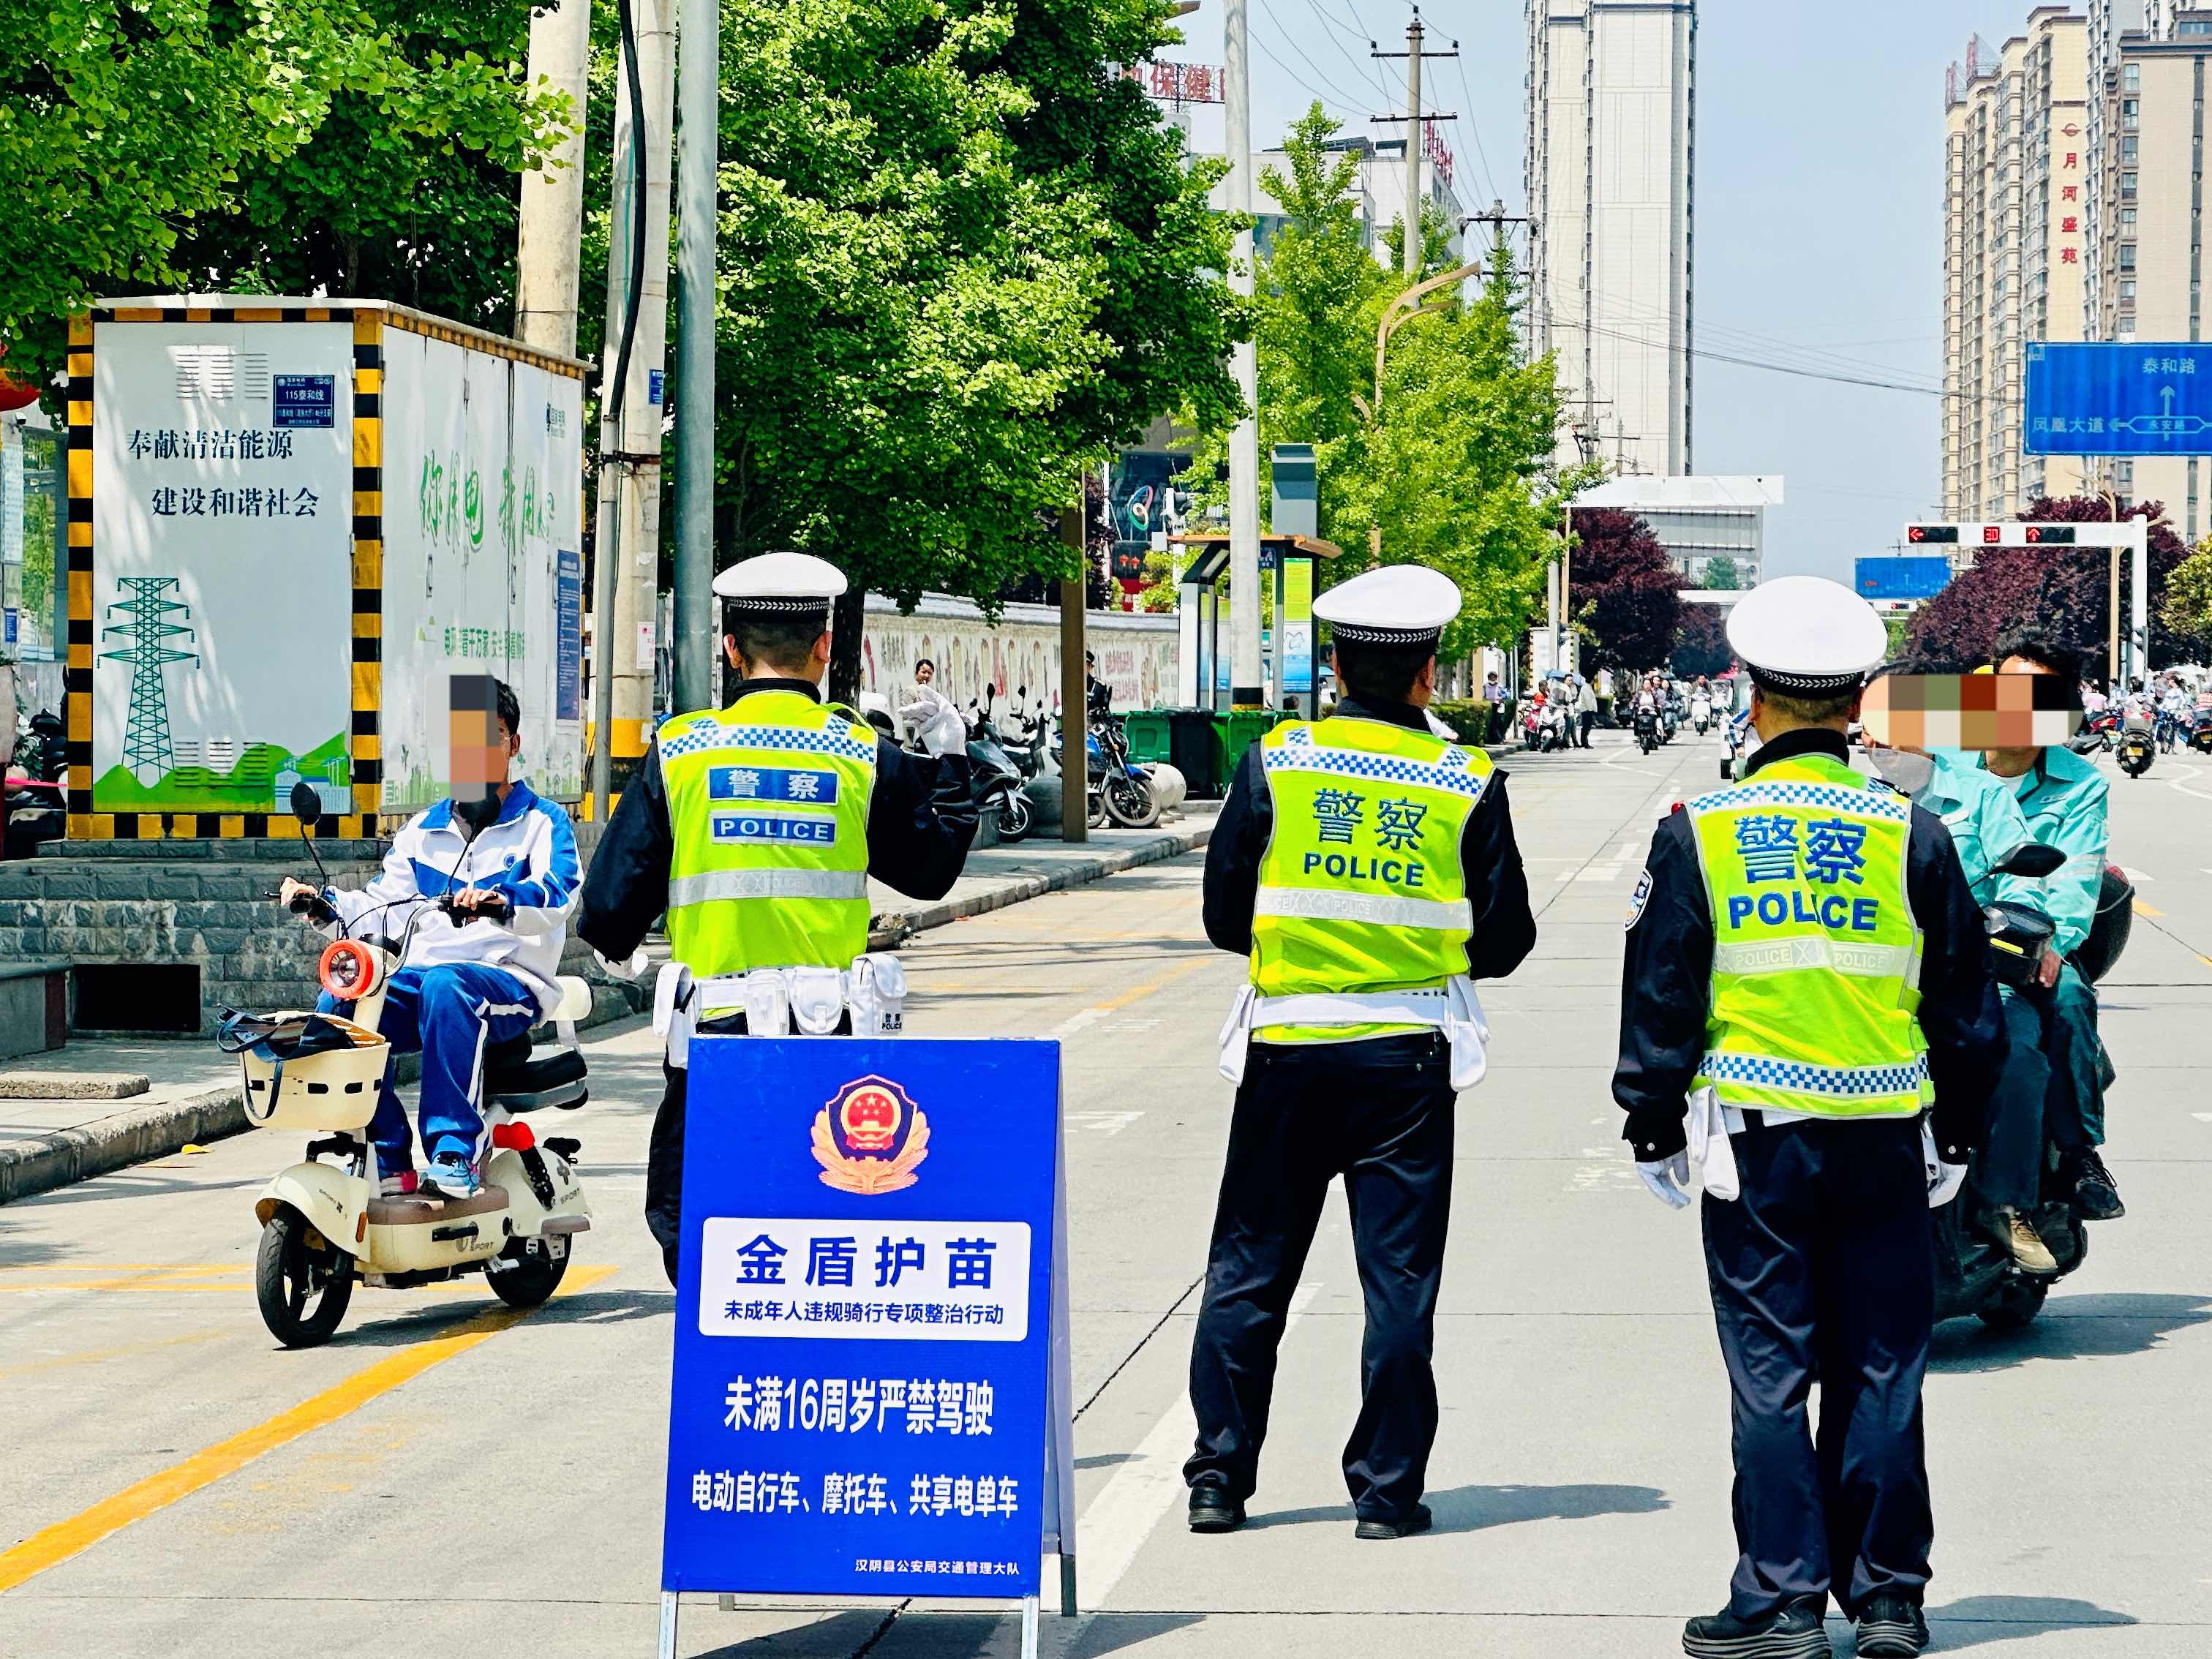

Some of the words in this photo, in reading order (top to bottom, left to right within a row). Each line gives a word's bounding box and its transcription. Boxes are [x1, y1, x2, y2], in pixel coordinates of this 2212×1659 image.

[2142, 357, 2195, 374] 泰和路
[2032, 417, 2104, 433] 凤凰大道
[127, 429, 293, 461] 奉献清洁能源
[152, 487, 319, 519] 建设和谐社会
[1985, 528, 1998, 541] 30
[729, 770, 819, 799] 警察
[721, 820, 830, 840] POLICE
[1313, 787, 1428, 851] 警察
[1734, 815, 1866, 885] 警察
[1304, 853, 1425, 887] POLICE
[1737, 947, 1791, 967] POLICE
[1835, 951, 1886, 968] POLICE
[737, 1234, 997, 1289] 金盾护苗
[724, 1300, 1004, 1325] 未成年人违规骑行专项整治行动
[724, 1375, 993, 1436] 未满16周岁严禁驾驶
[692, 1470, 1019, 1519] 电动自行车、摩托车、共享电单车
[855, 1559, 1020, 1576] 汉阴县公安局交通管理大队
